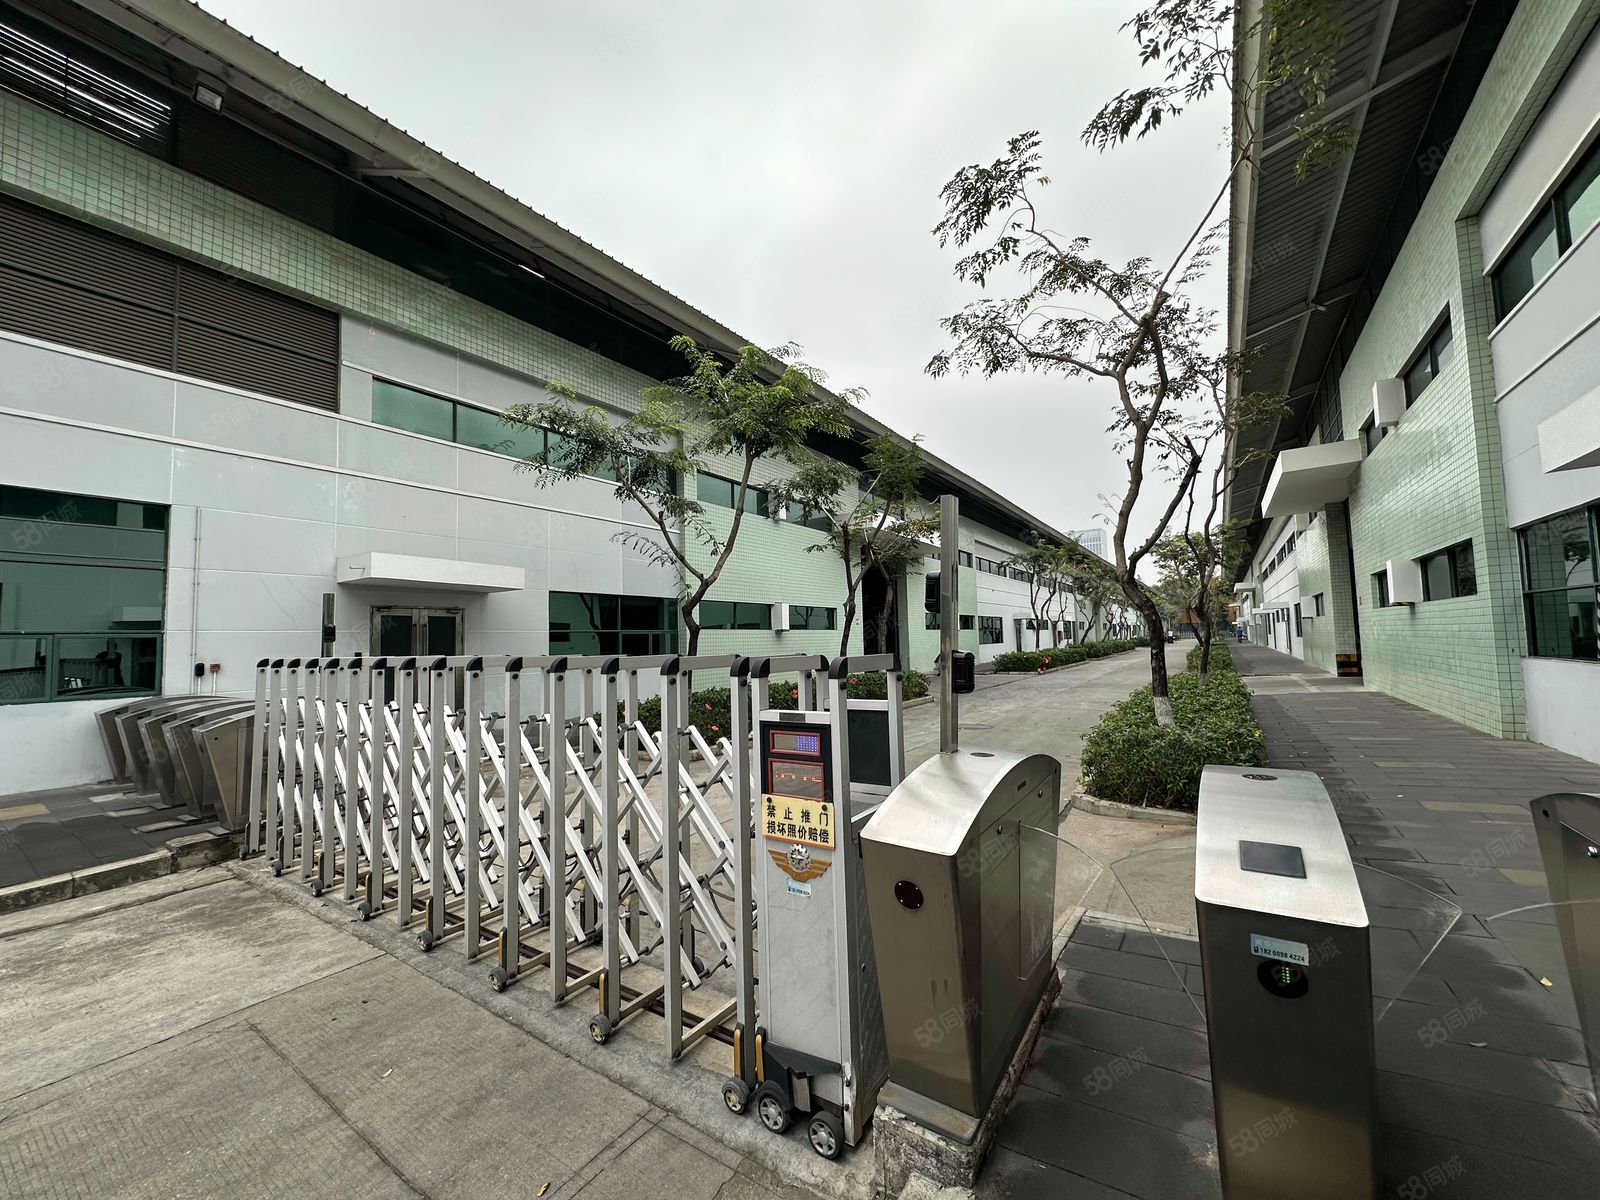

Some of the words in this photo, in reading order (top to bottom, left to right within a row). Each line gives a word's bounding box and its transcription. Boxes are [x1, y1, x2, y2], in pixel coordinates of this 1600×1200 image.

[767, 804, 829, 826] 禁止推门
[767, 820, 829, 844] 损坏照价赔偿
[1260, 947, 1271, 955] 182
[1289, 954, 1305, 962] 4224
